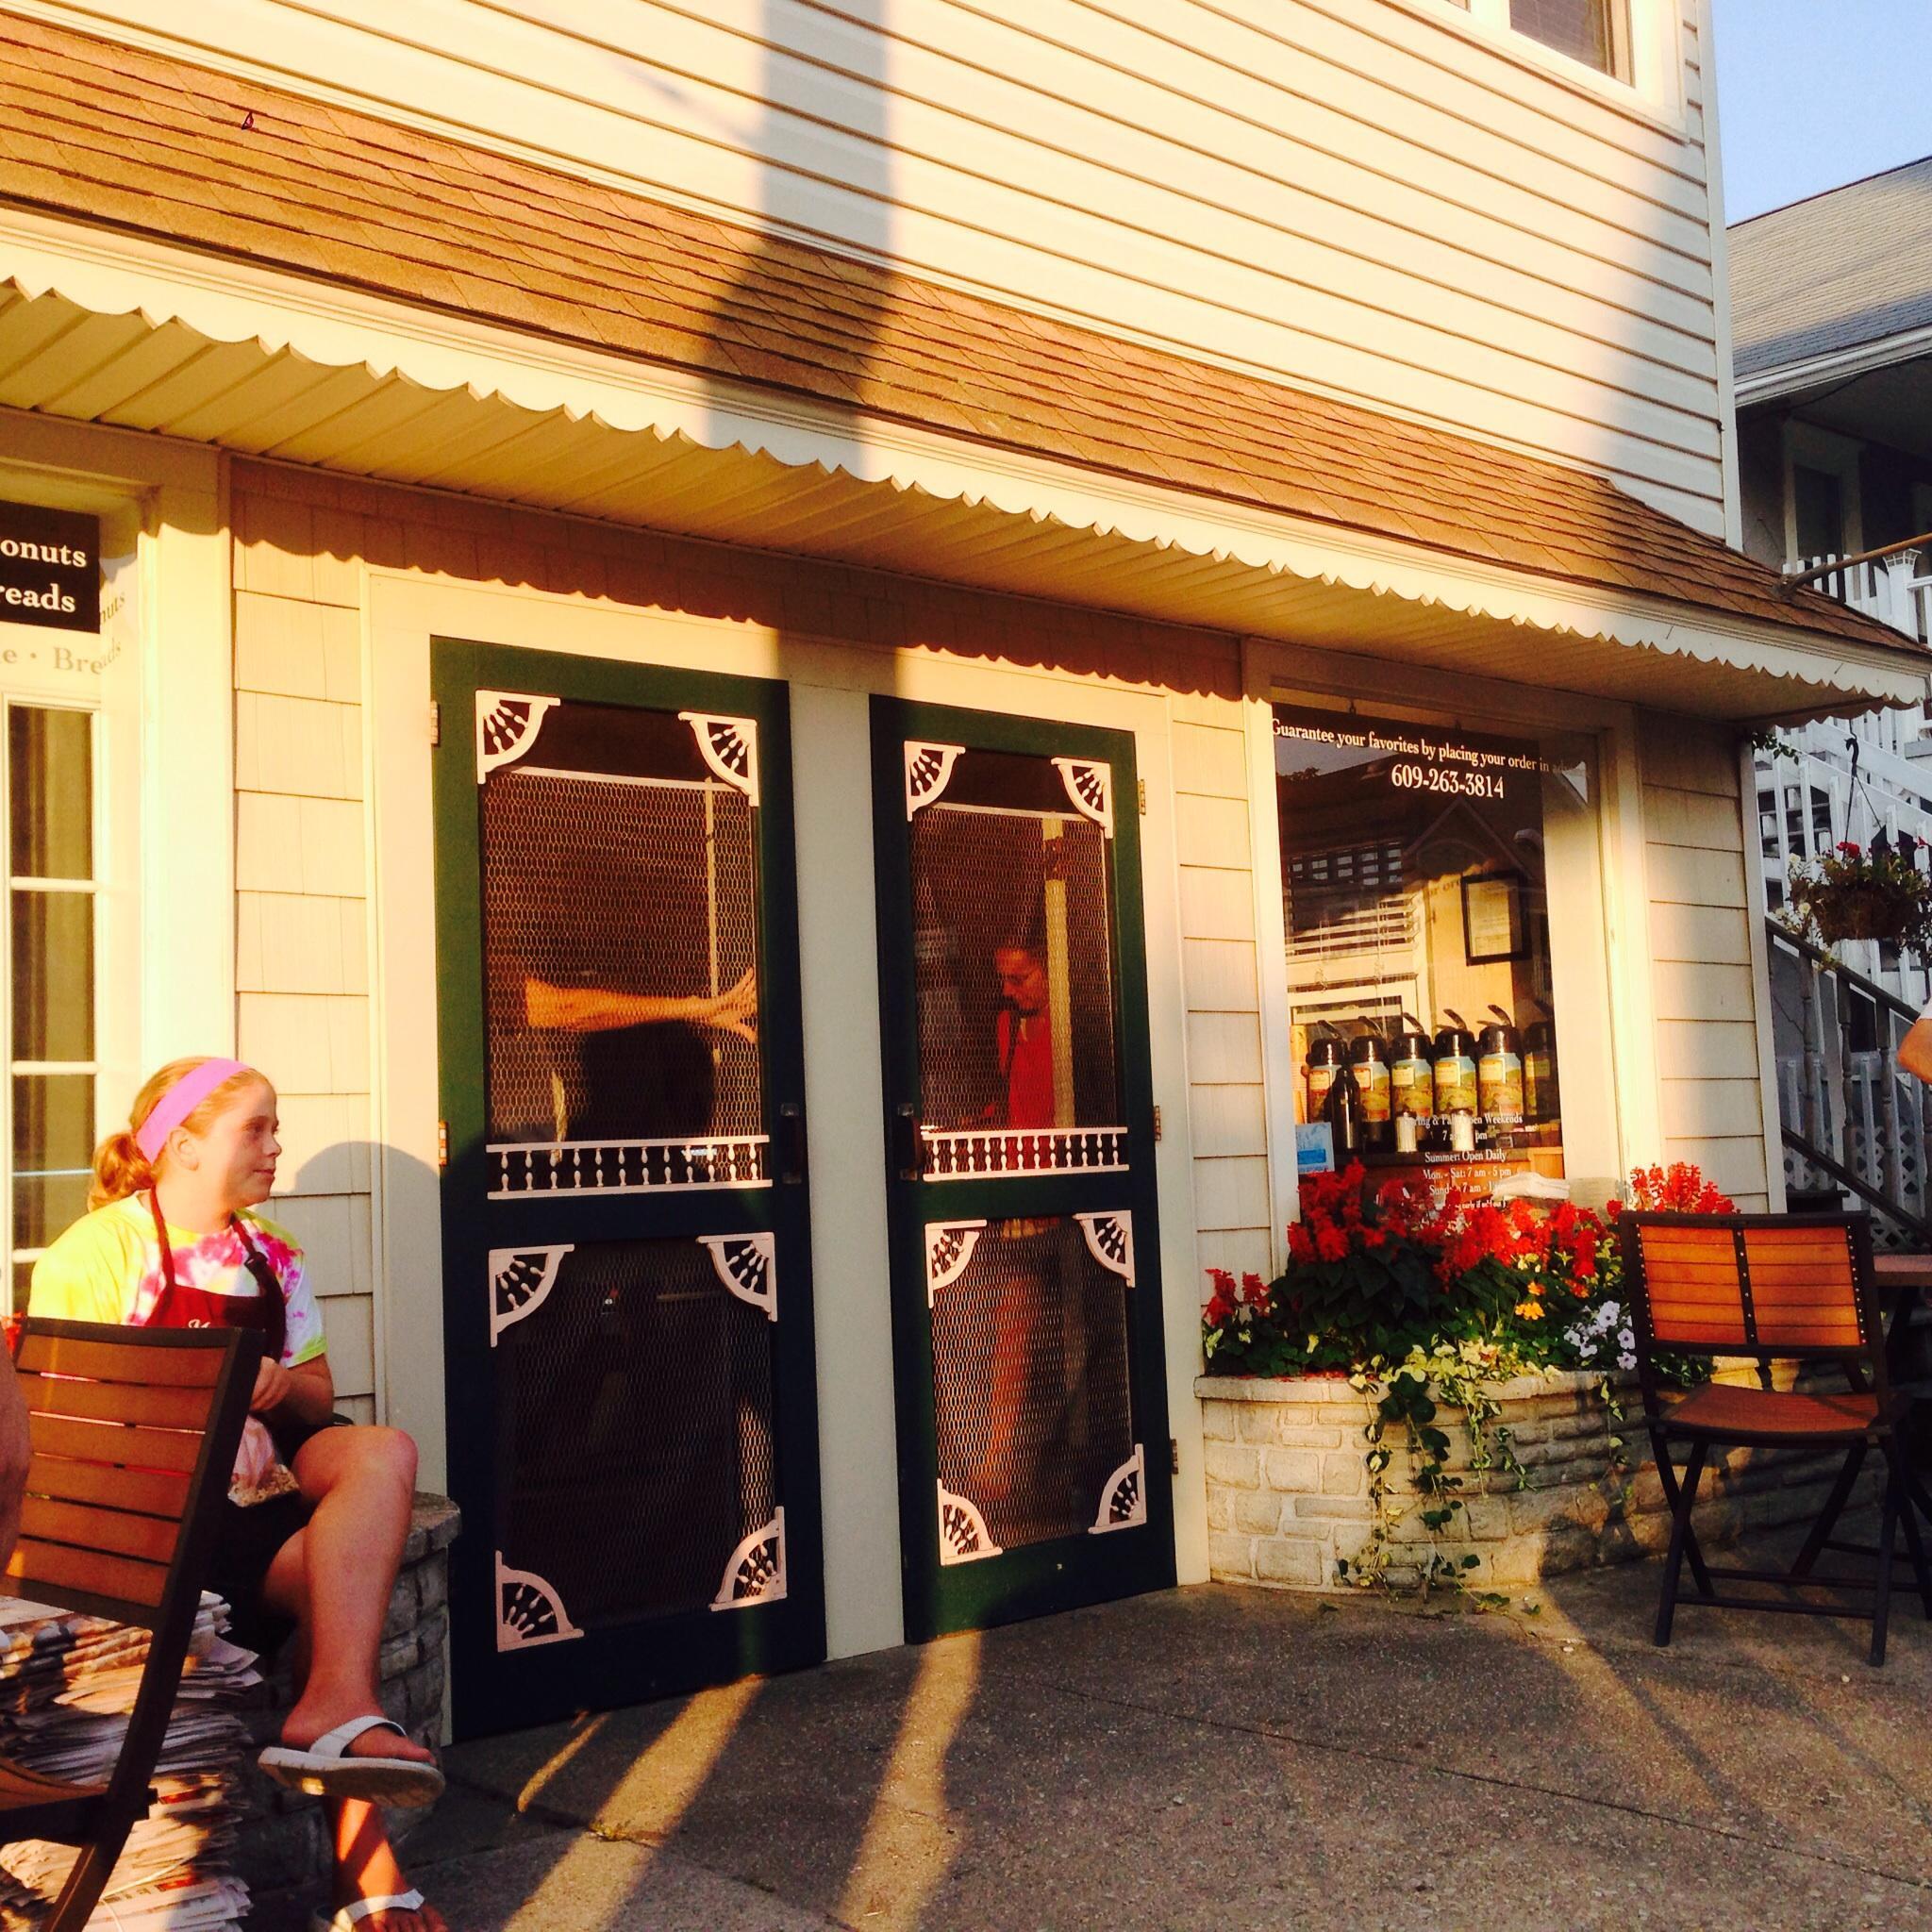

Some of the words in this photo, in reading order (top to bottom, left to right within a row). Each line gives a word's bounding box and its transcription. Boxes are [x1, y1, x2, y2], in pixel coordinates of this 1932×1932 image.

[0, 539, 88, 567] onuts
[1272, 718, 1335, 742] Guarantee
[1336, 733, 1366, 748] your
[1369, 731, 1419, 754] favorites
[1421, 739, 1436, 760] by
[1439, 742, 1479, 767] placing
[1480, 753, 1507, 767] your
[1508, 755, 1538, 770] order
[1540, 757, 1550, 772] in
[1391, 764, 1505, 799] 609-263-3814
[1484, 1111, 1524, 1124] Weekends
[1424, 1151, 1460, 1163] Summer:
[1461, 1150, 1484, 1163] Open
[1485, 1148, 1507, 1162] Daily
[1467, 1167, 1473, 1177] 7
